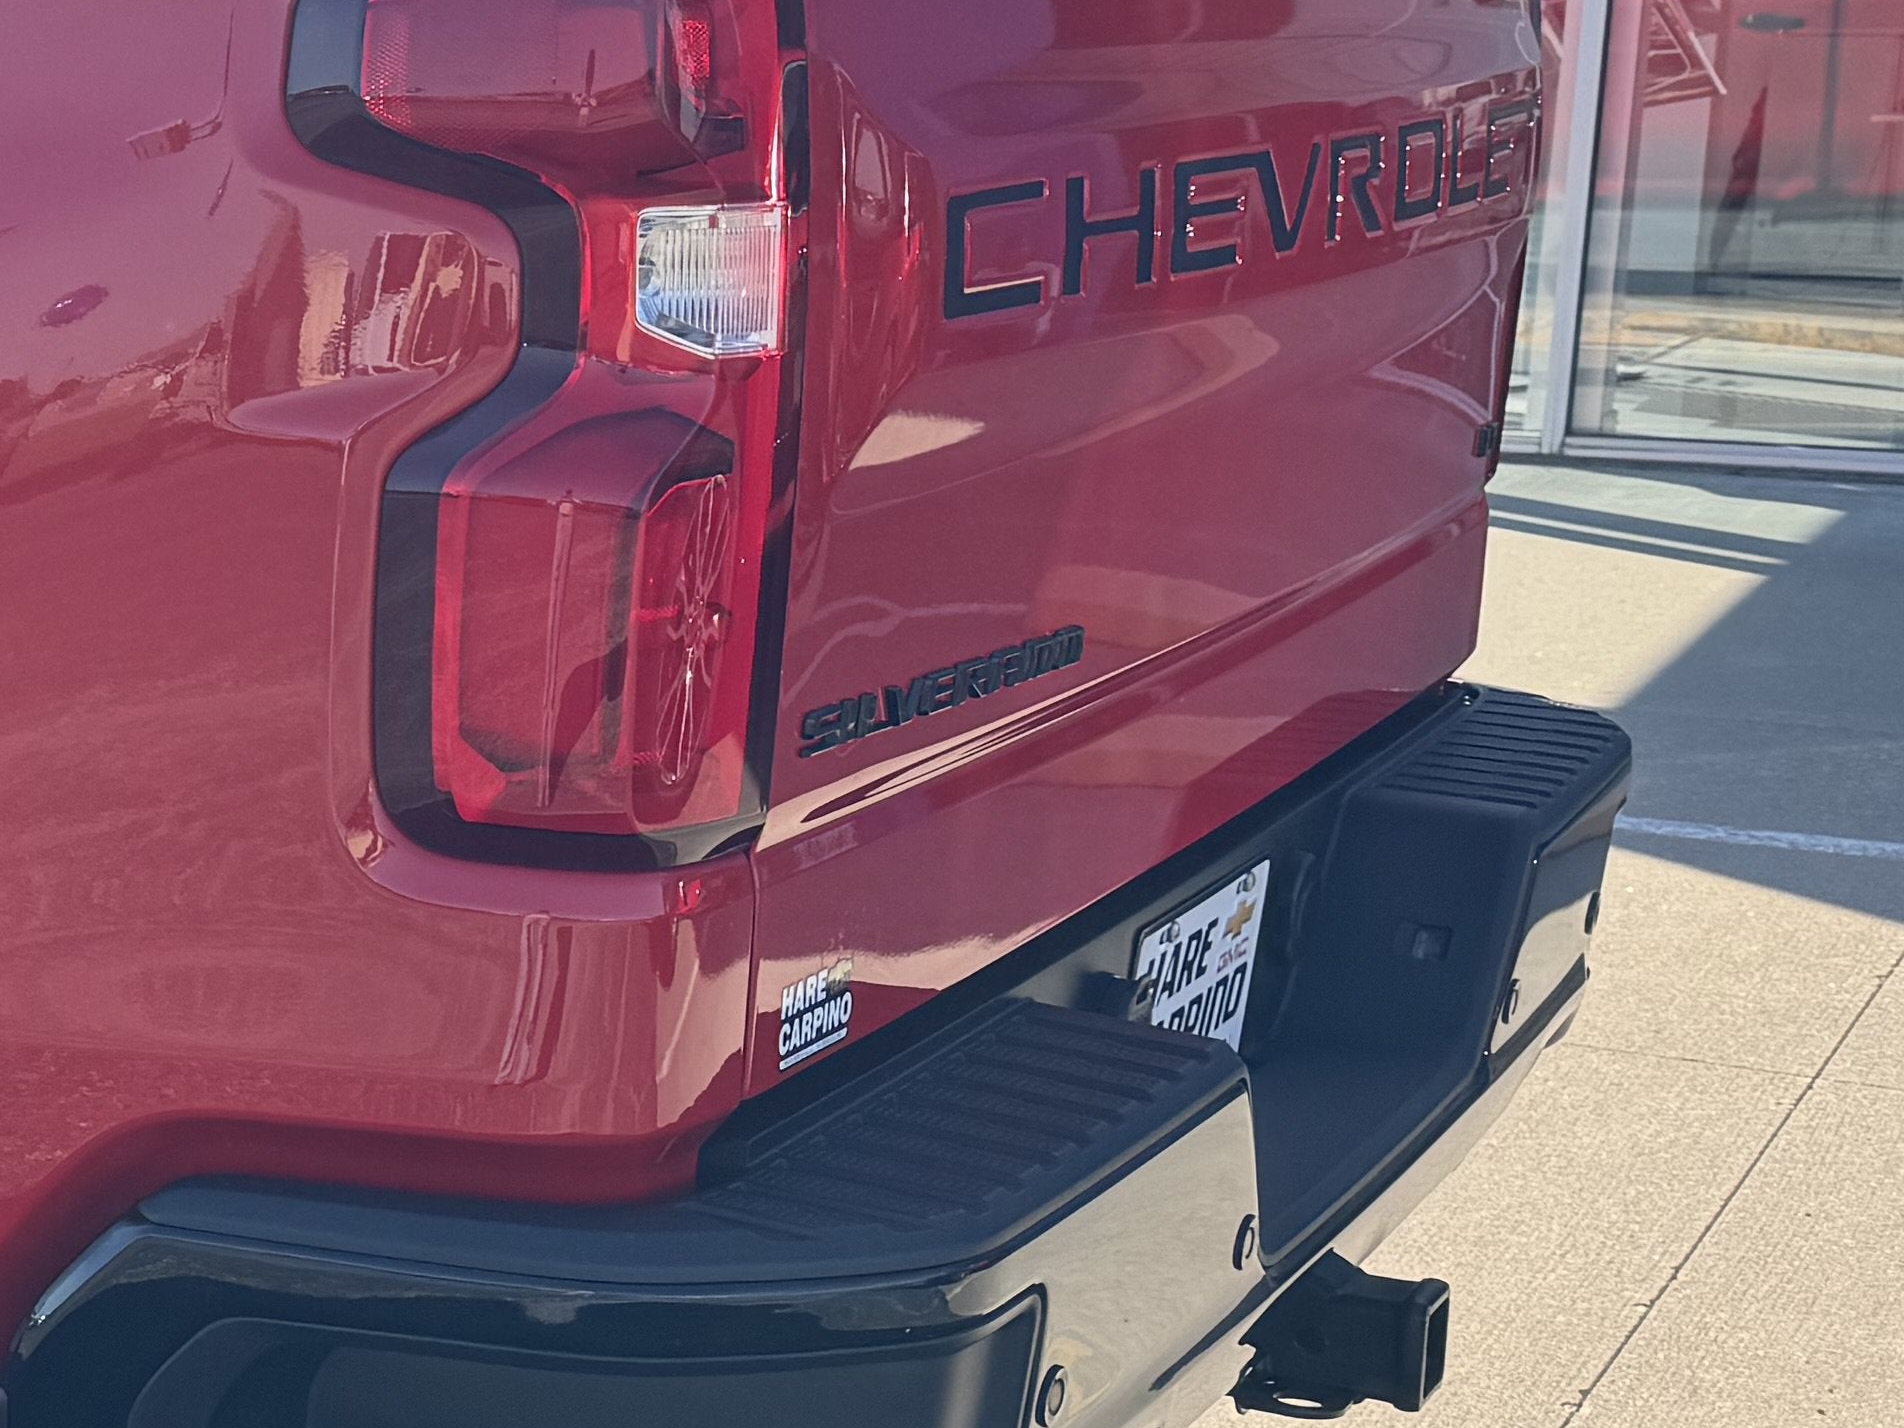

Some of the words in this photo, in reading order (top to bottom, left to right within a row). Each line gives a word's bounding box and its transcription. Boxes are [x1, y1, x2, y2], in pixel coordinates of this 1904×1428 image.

[799, 625, 1085, 758] SILVERADO
[780, 968, 829, 1021] HARE
[1135, 916, 1219, 1007] HARE
[778, 991, 853, 1057] CARPINO
